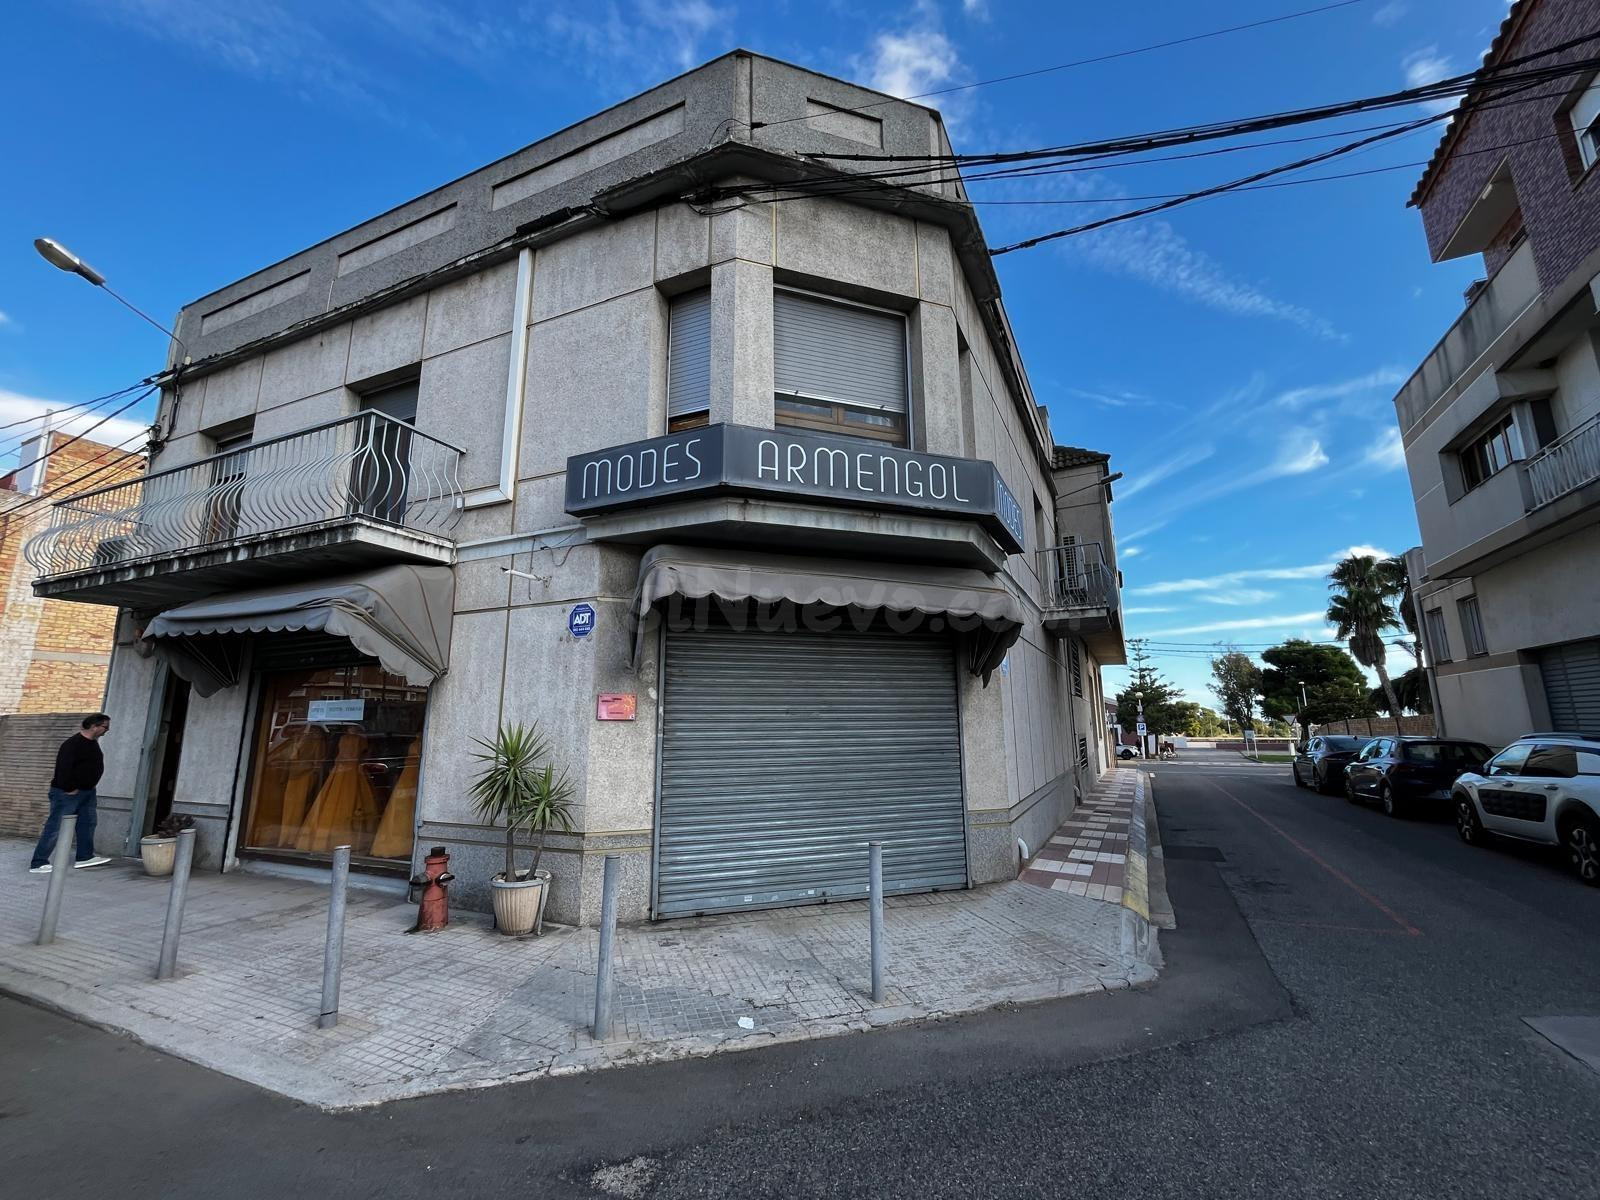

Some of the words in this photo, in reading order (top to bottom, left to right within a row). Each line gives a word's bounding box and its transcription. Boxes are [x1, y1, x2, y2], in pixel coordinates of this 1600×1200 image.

[581, 438, 702, 499] MODES
[757, 439, 970, 503] ARMENGOL
[573, 612, 591, 625] ADT
